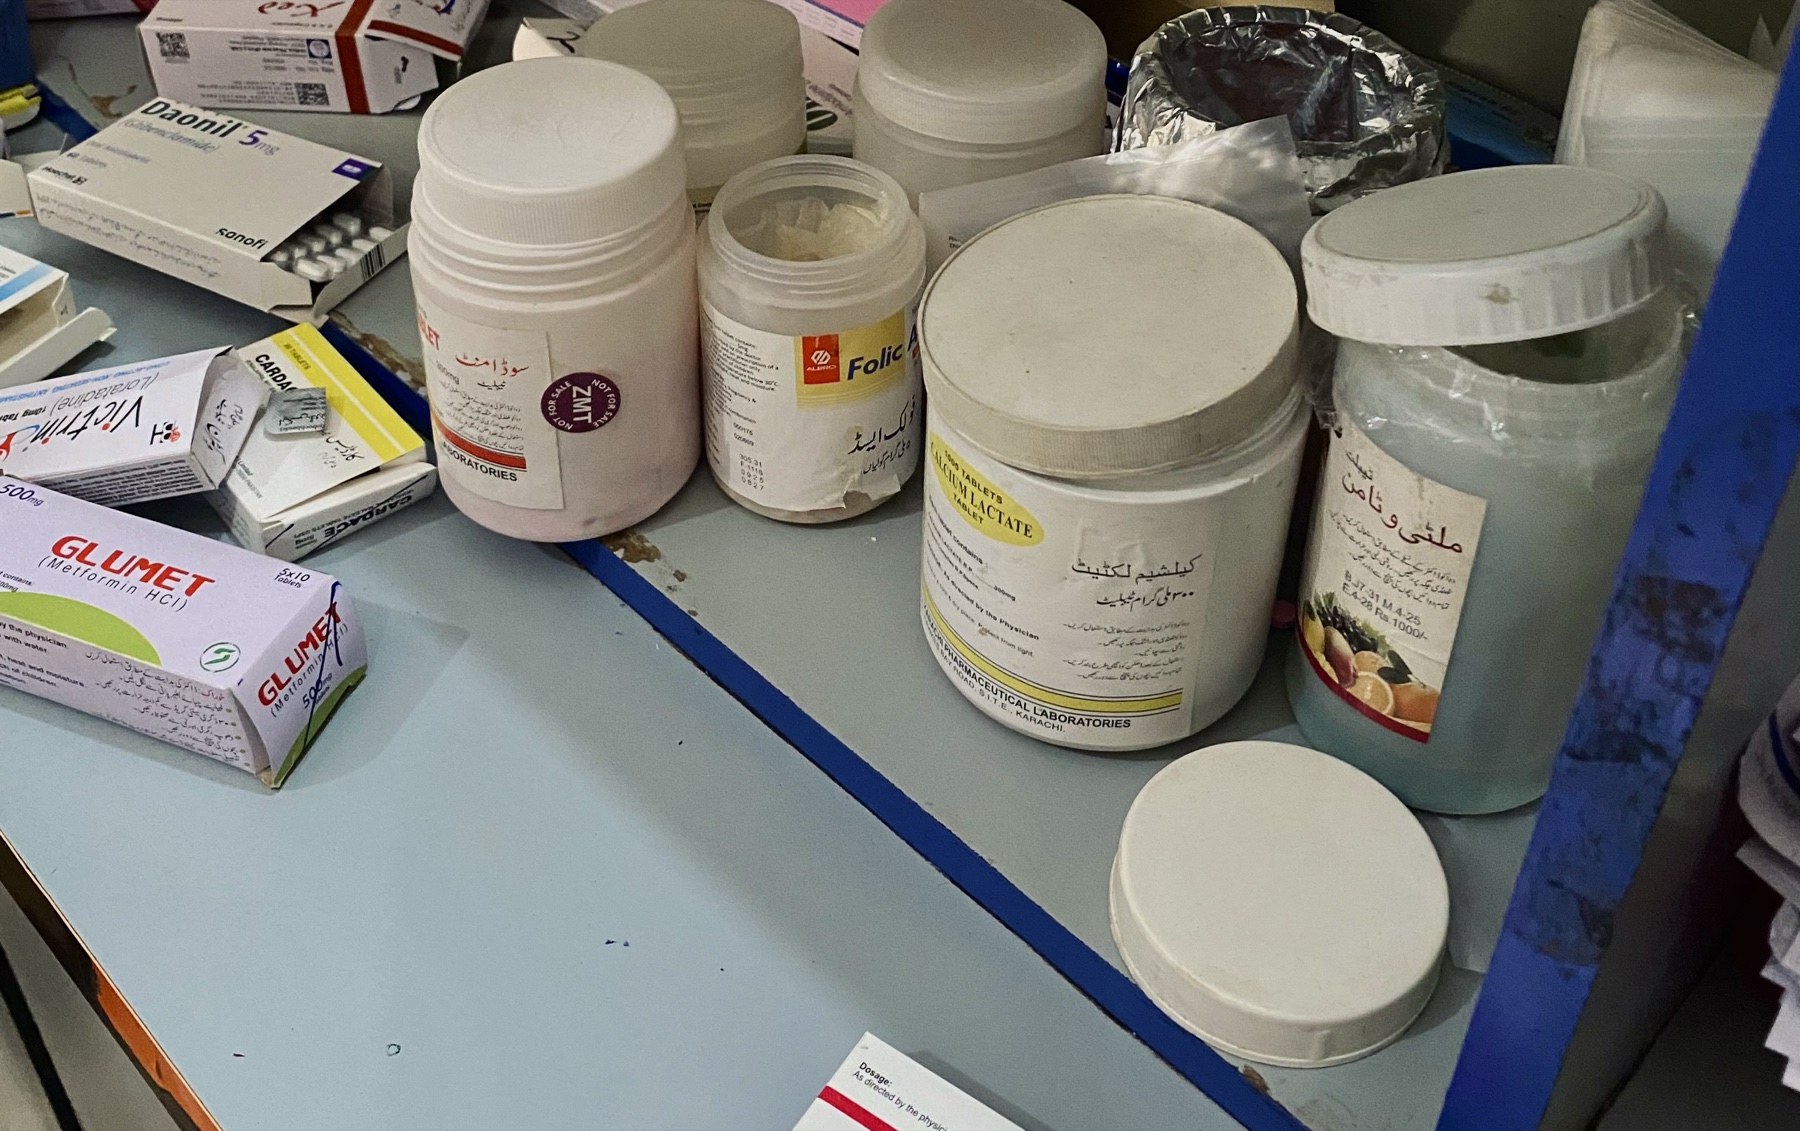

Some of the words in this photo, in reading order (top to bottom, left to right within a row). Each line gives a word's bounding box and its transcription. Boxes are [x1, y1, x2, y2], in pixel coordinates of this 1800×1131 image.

[141, 101, 244, 138] Daonil
[216, 227, 269, 249] sanofi
[847, 343, 904, 381] Folic
[50, 372, 159, 416] (Loratadine)
[551, 381, 572, 398] SALE
[591, 379, 612, 393] NOT
[607, 393, 616, 410] FOR
[548, 400, 558, 416] FOR
[572, 385, 592, 423] ZMT
[593, 411, 613, 428] SALE
[553, 417, 574, 430] NOT
[931, 441, 968, 500] CALCIUM
[970, 491, 1033, 538] LACTATE
[961, 468, 1003, 505] TABLETS
[324, 494, 413, 539] CARDACE
[953, 493, 984, 525] TABLET
[38, 554, 139, 596] (Metformin
[144, 590, 189, 613] HCl)
[50, 535, 216, 598] GLUMET
[274, 574, 302, 589] Tablets
[279, 567, 311, 583] 5x10
[985, 609, 998, 622] the
[999, 618, 1040, 641] Physician
[257, 601, 342, 707] GLUMET
[270, 653, 324, 718] (Metformin
[944, 643, 1031, 713] PHARMACEUTICAL
[1032, 705, 1132, 729] LABORATORIES
[1015, 710, 1067, 733] KARACHI.
[858, 1061, 893, 1088] Dosage:
[852, 1070, 865, 1081] As
[864, 1076, 896, 1102] directed
[894, 1095, 905, 1110] by
[905, 1103, 920, 1118] the
